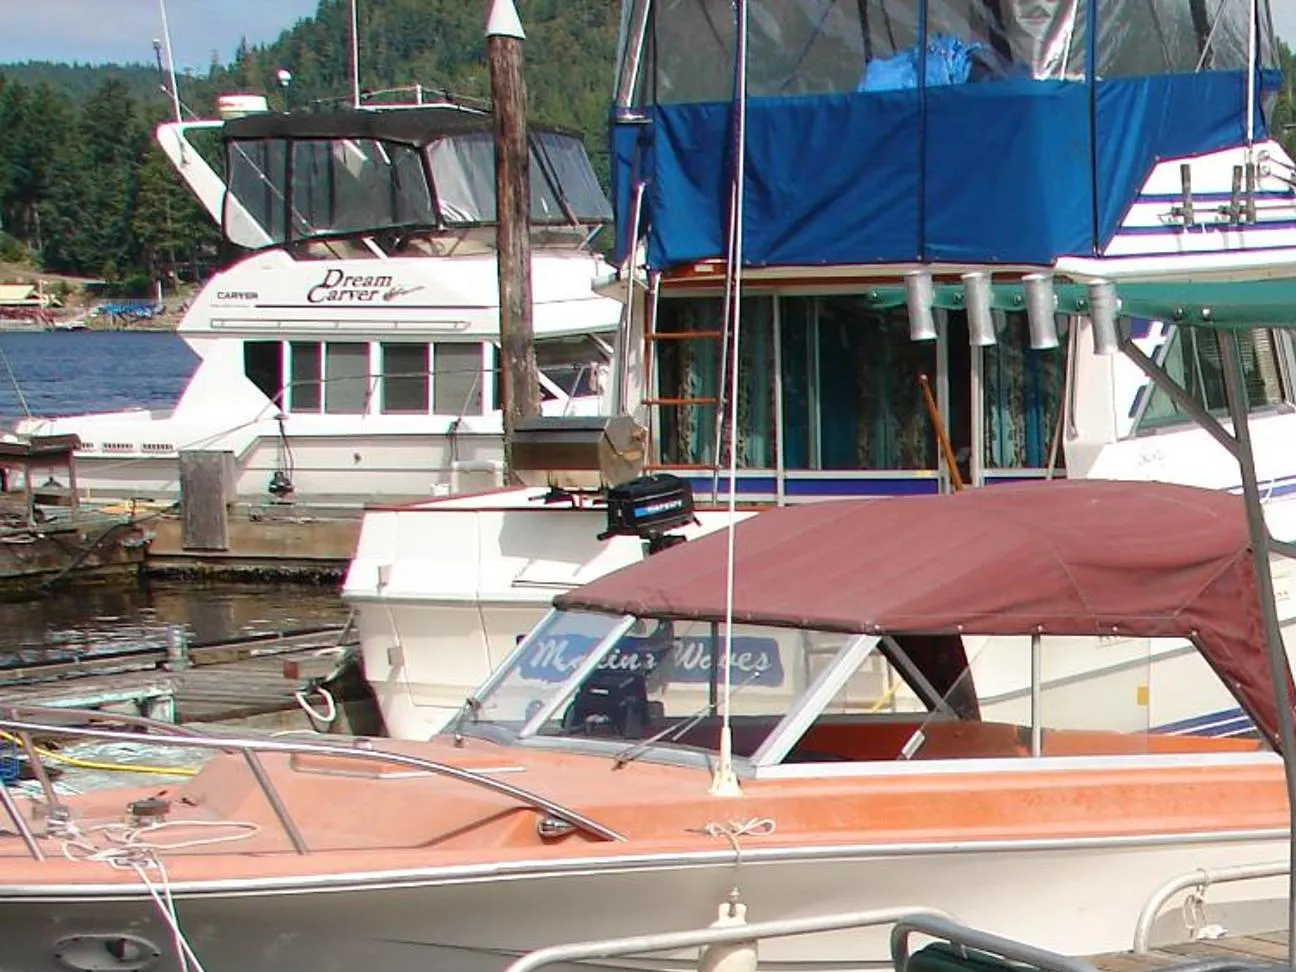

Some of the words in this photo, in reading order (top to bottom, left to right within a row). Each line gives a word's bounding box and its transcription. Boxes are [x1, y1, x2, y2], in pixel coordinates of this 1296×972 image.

[321, 268, 392, 288] Dream
[217, 291, 259, 300] CARVER
[306, 284, 379, 303] Carver
